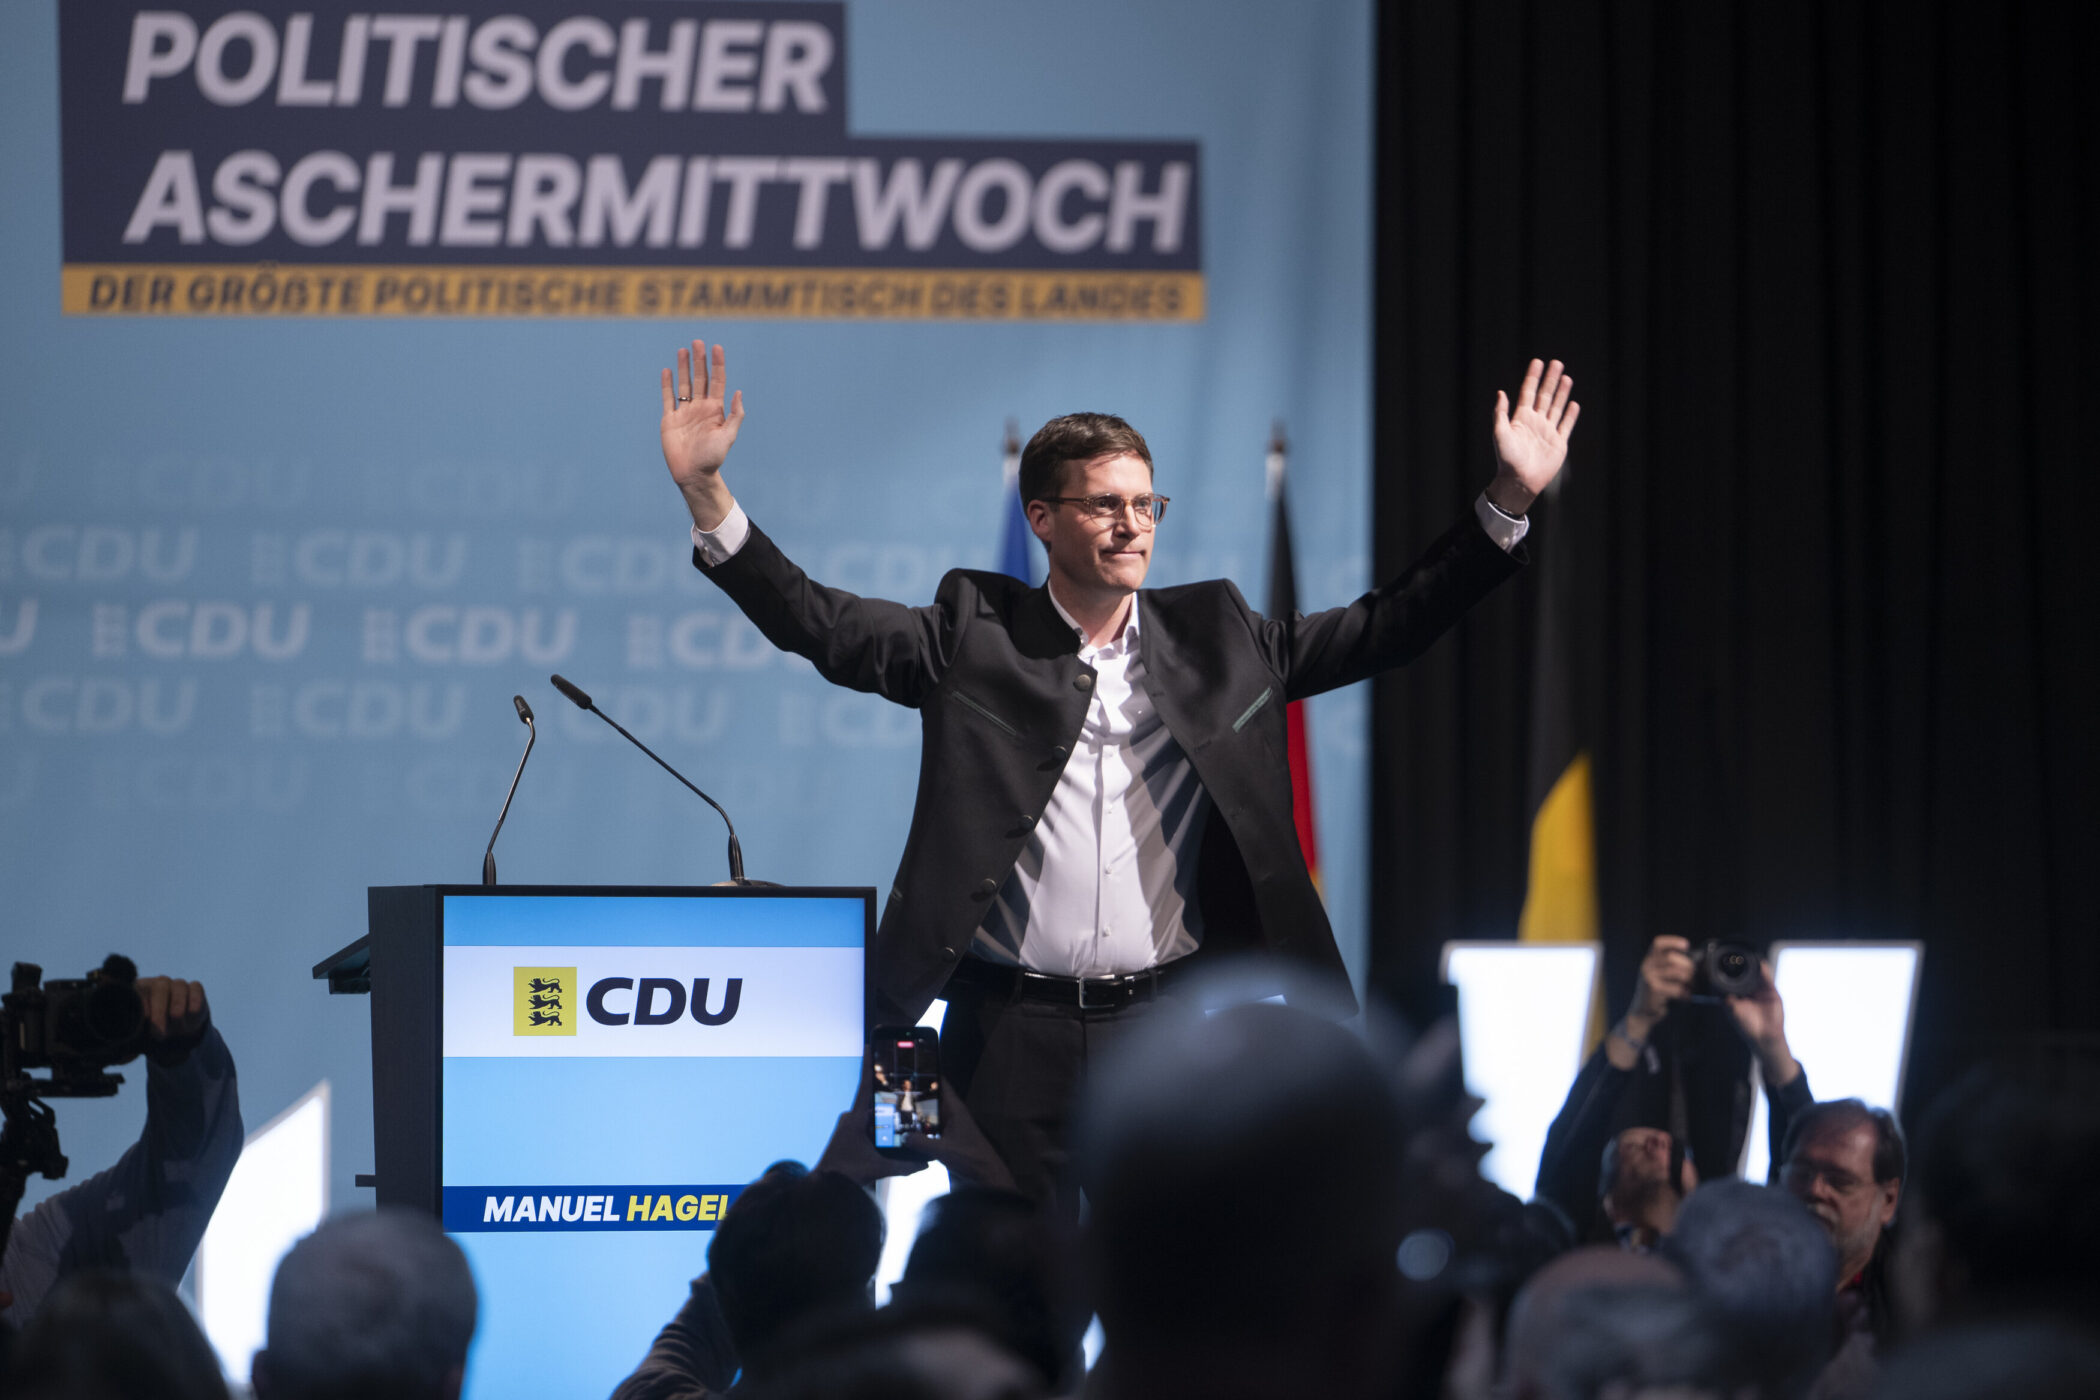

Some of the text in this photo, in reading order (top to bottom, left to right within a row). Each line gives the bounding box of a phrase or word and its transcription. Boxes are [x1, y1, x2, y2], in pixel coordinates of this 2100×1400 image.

[122, 11, 833, 113] POLITISCHER
[122, 151, 1191, 253] ASCHERMITTWOCH
[88, 272, 175, 312] DER
[374, 274, 626, 315] POLITISCHE
[637, 276, 926, 317] STAMMTISCH
[929, 278, 1012, 318] DES
[1017, 280, 1186, 318] LANDES
[21, 526, 199, 584] CDU
[294, 529, 468, 589] CDU
[135, 600, 815, 672] CDU CDU CD
[21, 676, 199, 736] CDU
[293, 680, 468, 741] CDU
[586, 977, 743, 1026] CDU
[483, 1195, 620, 1222] MANUEL
